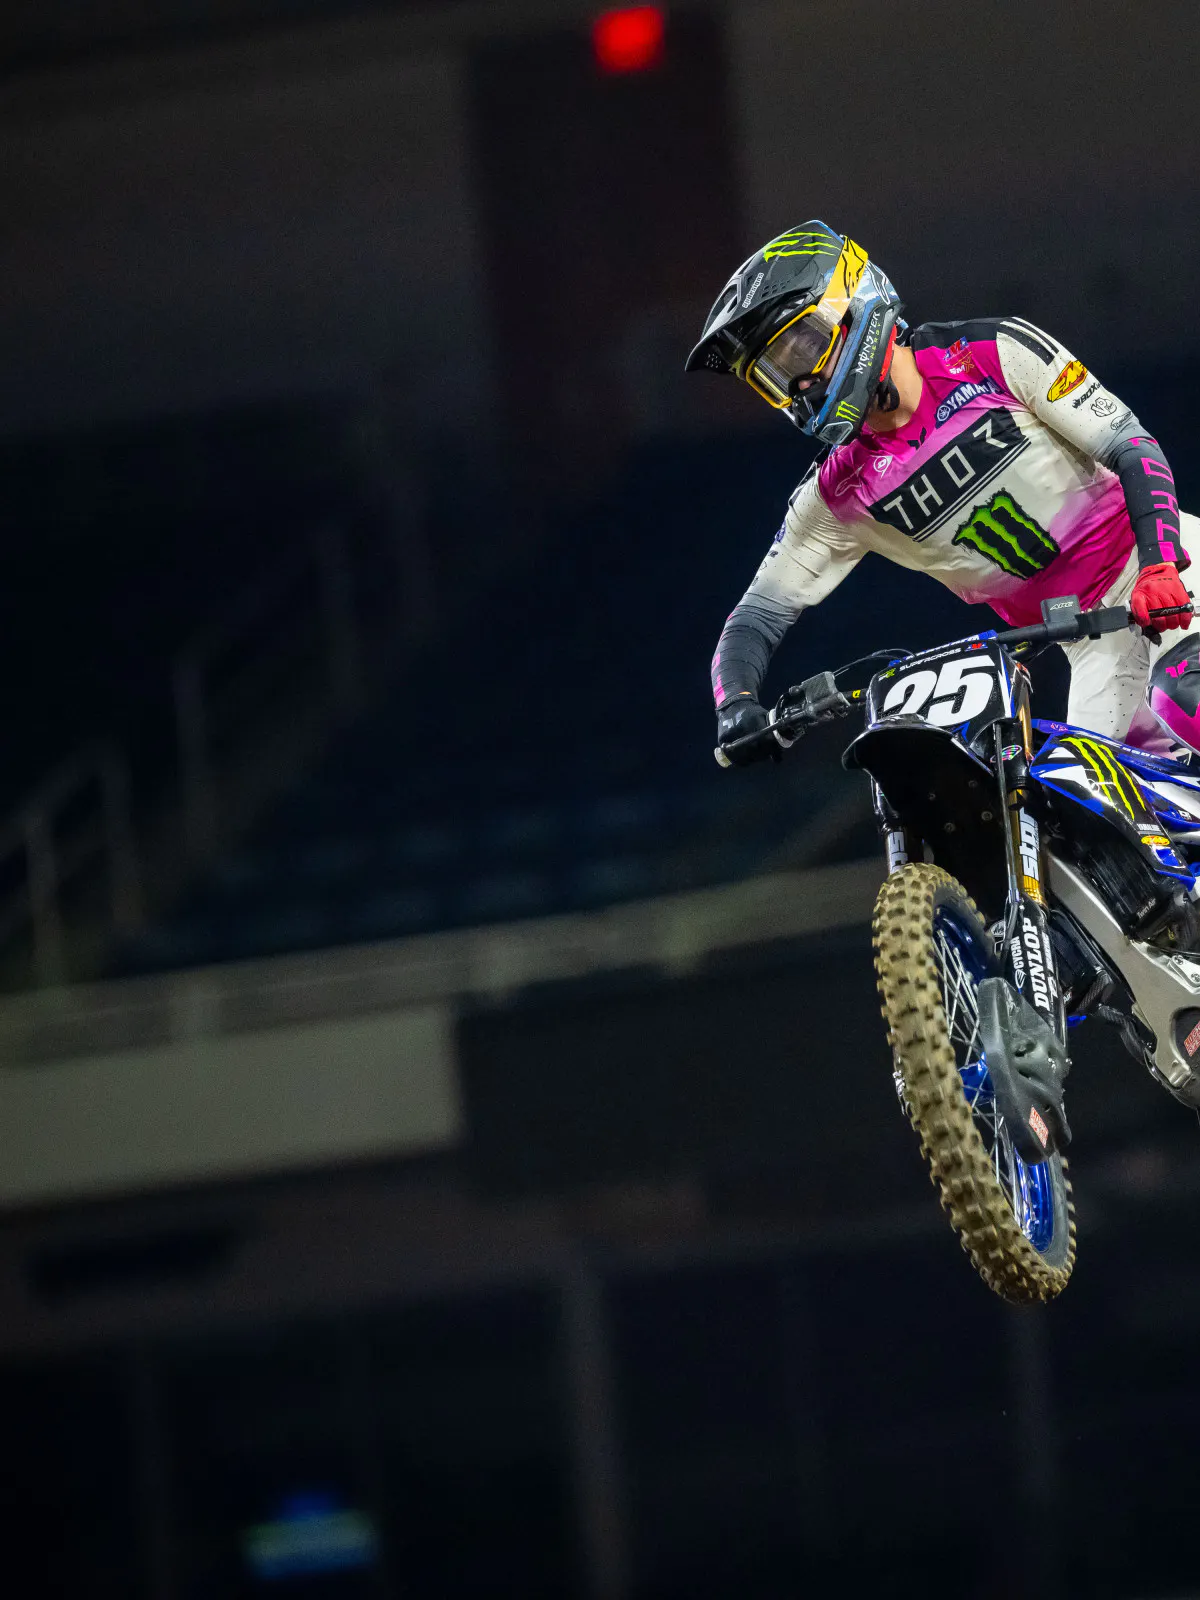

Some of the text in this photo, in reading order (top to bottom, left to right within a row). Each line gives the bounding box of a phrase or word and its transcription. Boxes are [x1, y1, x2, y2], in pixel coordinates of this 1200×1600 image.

[855, 311, 880, 374] MONSTER
[883, 654, 996, 727] 25
[1022, 917, 1051, 1012] DUNLOP
